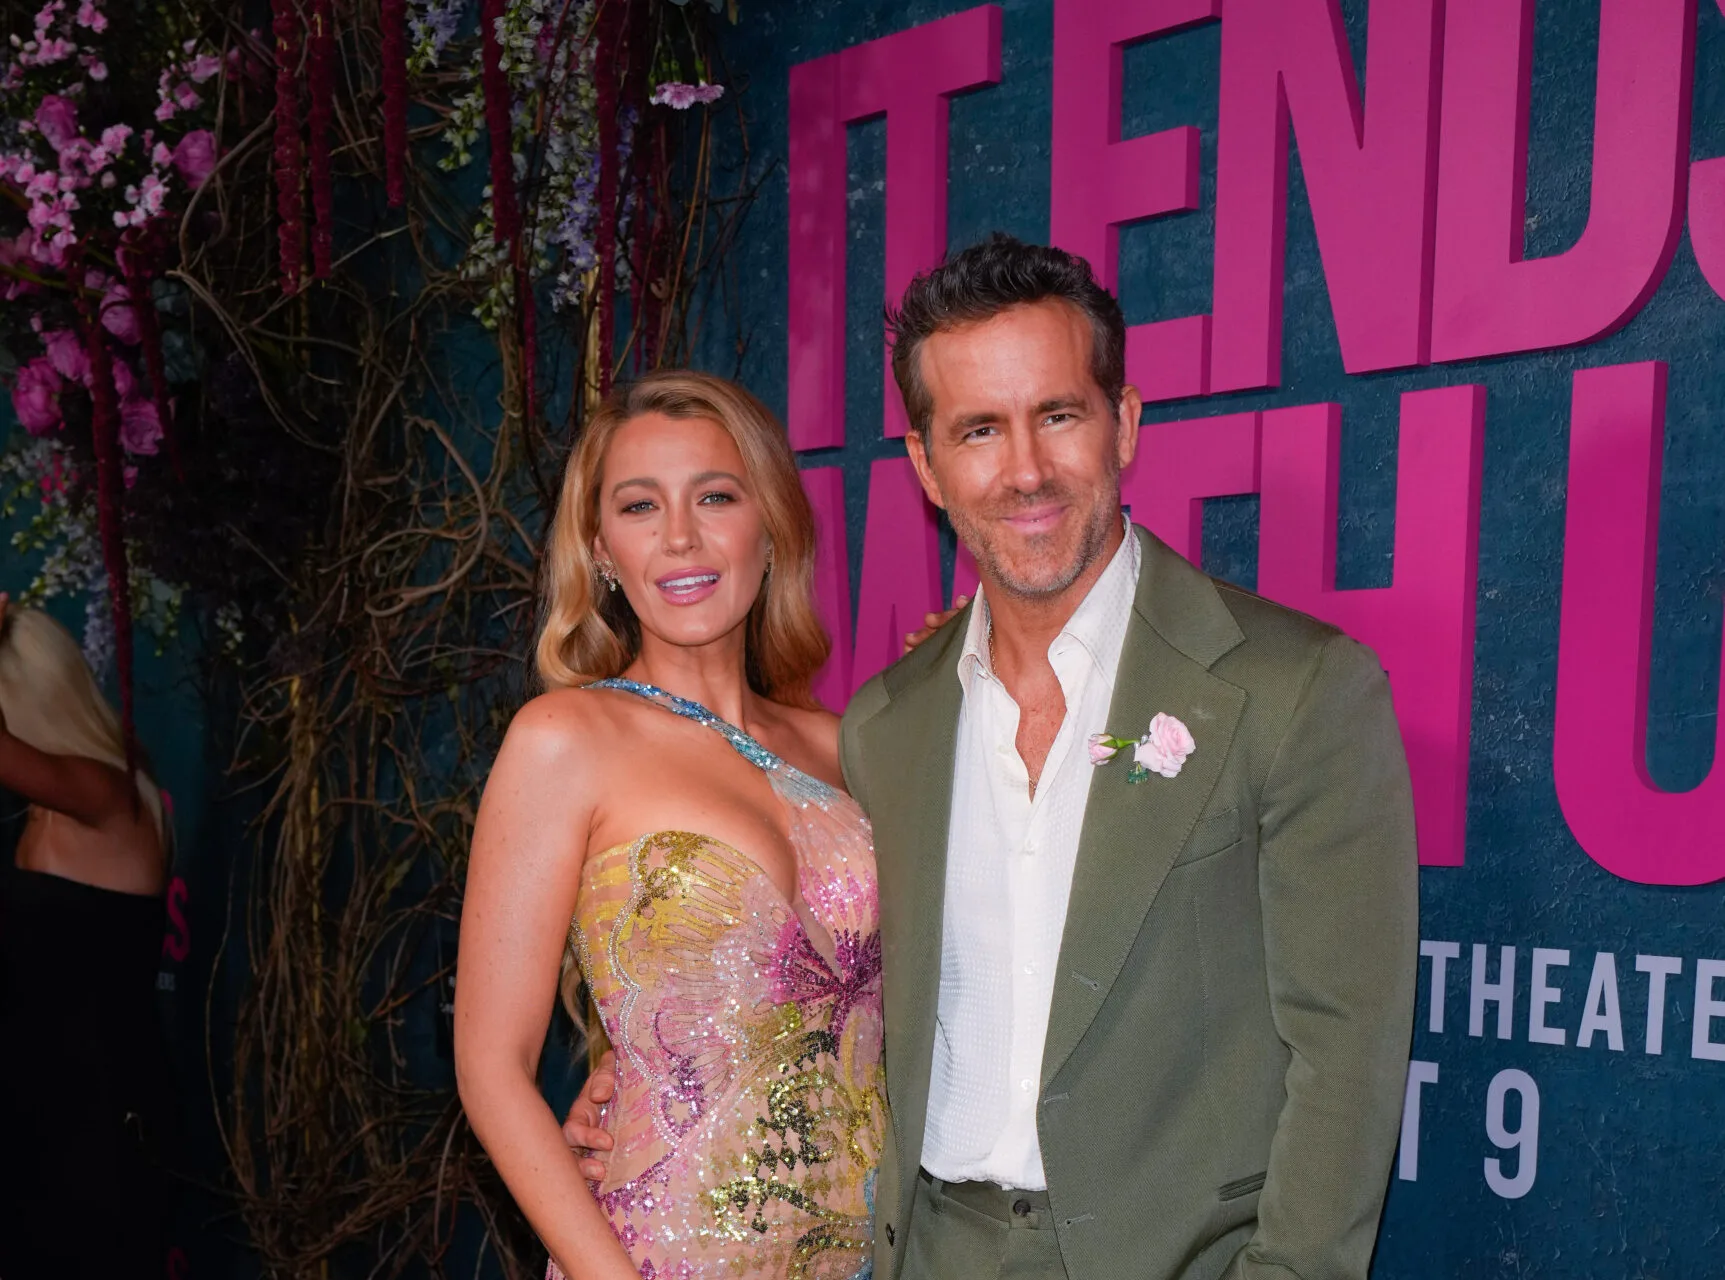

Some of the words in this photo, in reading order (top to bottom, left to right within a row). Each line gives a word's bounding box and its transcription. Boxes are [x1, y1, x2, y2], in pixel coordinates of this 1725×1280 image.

[788, 4, 1003, 452] IT
[1051, 0, 1725, 403] END
[1483, 1068, 1541, 1200] 9
